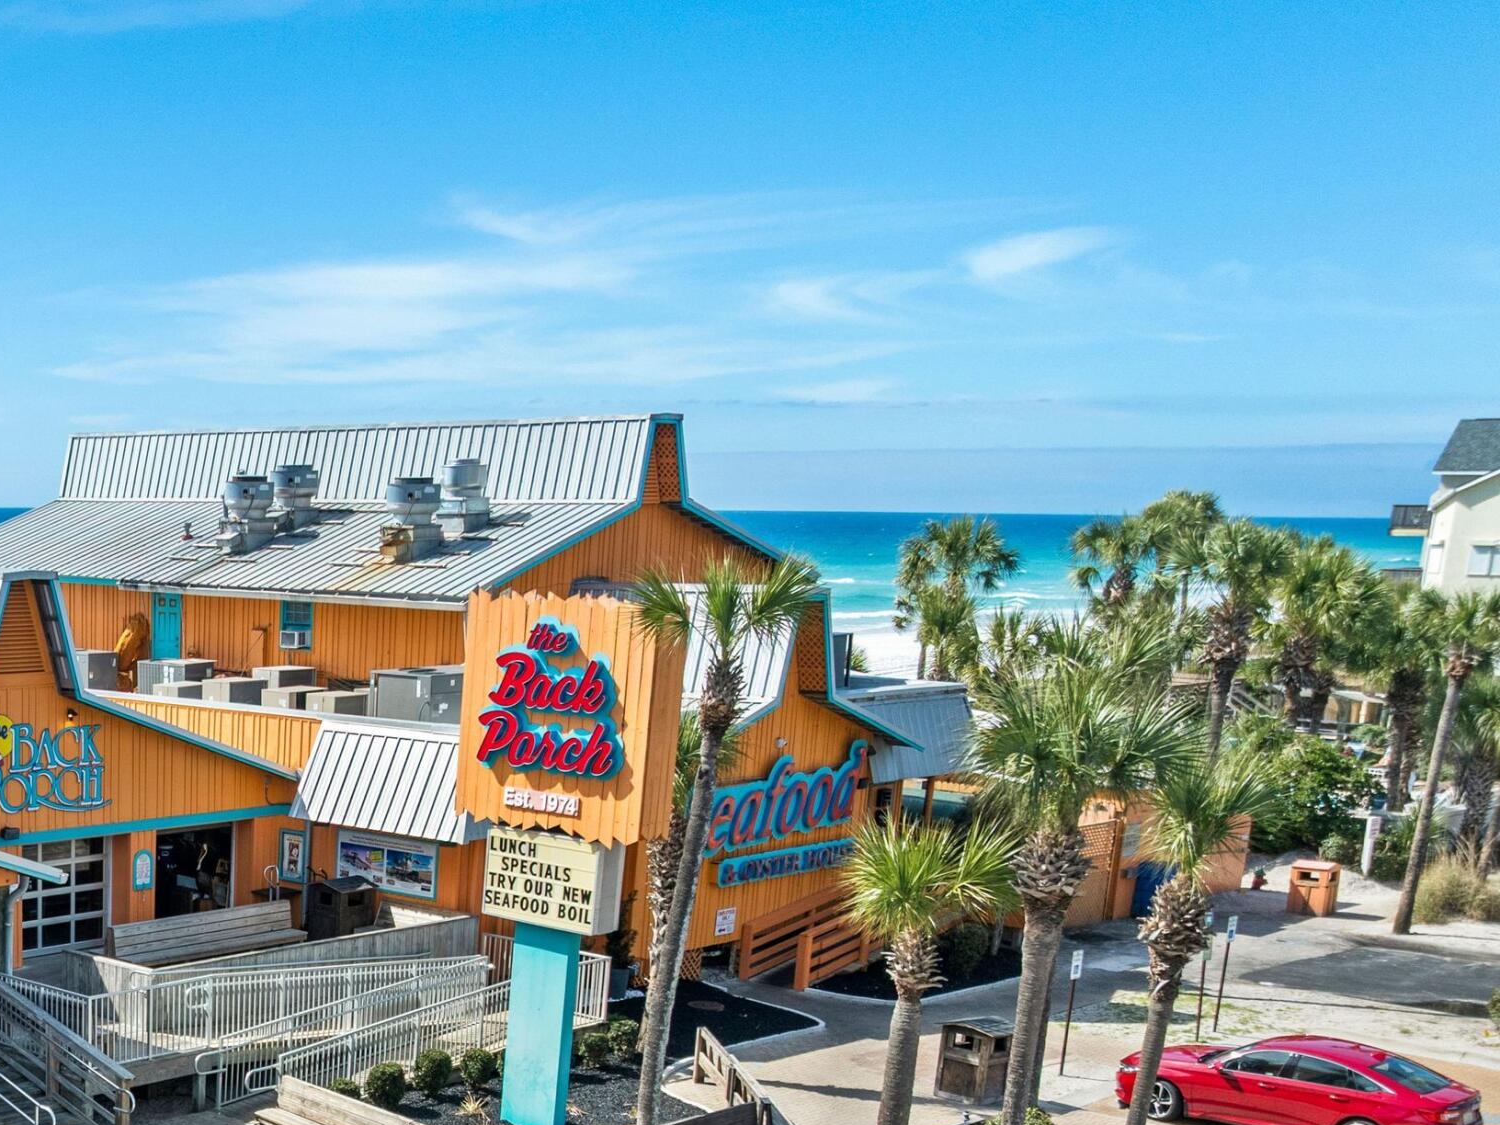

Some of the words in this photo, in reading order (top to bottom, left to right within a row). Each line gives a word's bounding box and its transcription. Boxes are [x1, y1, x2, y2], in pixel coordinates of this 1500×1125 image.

[527, 623, 569, 653] the
[488, 651, 605, 713] Back
[9, 723, 102, 773] BACK
[477, 710, 613, 777] Porch
[504, 787, 534, 810] Est.
[540, 793, 579, 816] 1974
[706, 747, 867, 850] eafood
[490, 836, 537, 859] LUNCH
[501, 856, 571, 883] SPECIALS
[740, 854, 800, 880] OYSTER
[489, 871, 520, 891] TRY
[524, 878, 553, 898] OUR
[562, 886, 592, 906] NEW
[485, 889, 549, 916] SEAFOOD
[557, 903, 592, 925] BOIL
